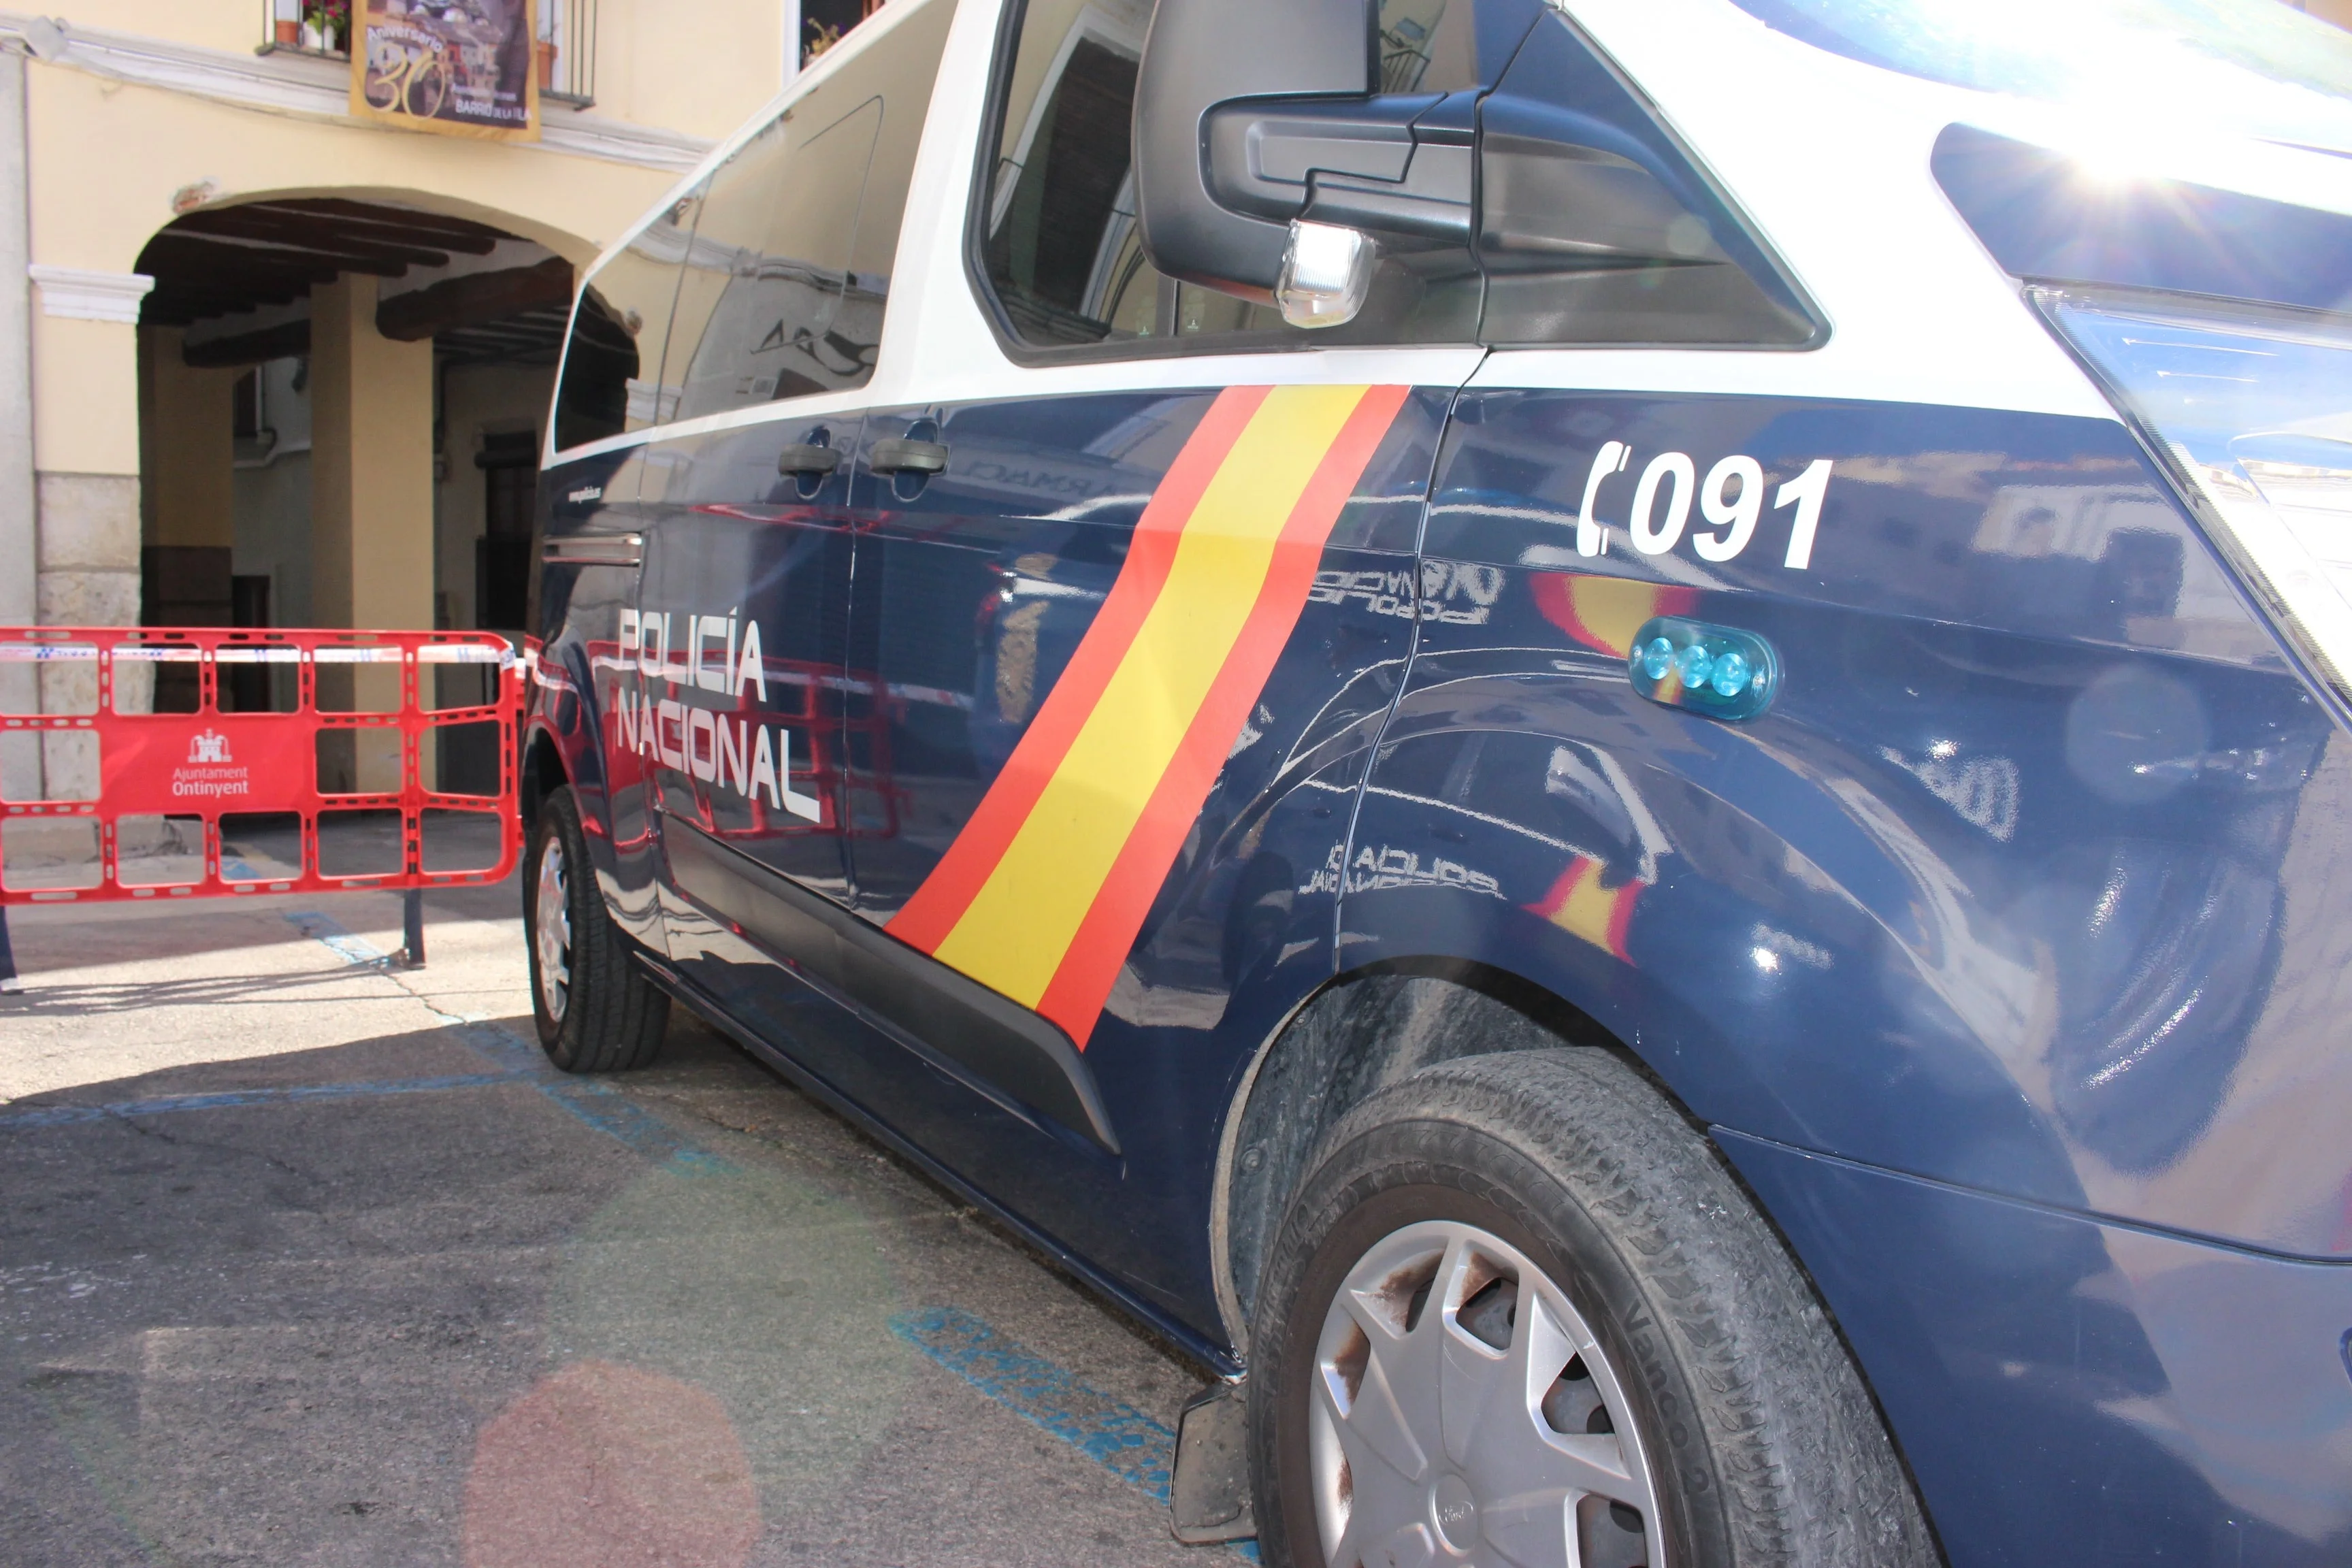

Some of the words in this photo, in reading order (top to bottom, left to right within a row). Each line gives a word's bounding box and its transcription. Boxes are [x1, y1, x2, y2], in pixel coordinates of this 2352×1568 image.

[368, 26, 442, 53] Aniversario
[365, 42, 445, 121] 30
[455, 99, 493, 117] BARRIO
[1630, 451, 1833, 570] 091
[619, 606, 767, 702] POLICÍA
[172, 781, 248, 798] Ontinyent
[173, 766, 248, 782] Ajuntament
[618, 687, 821, 823] NACIONAL
[1624, 1298, 1689, 1449] Vanco
[1680, 1466, 1710, 1496] 2
